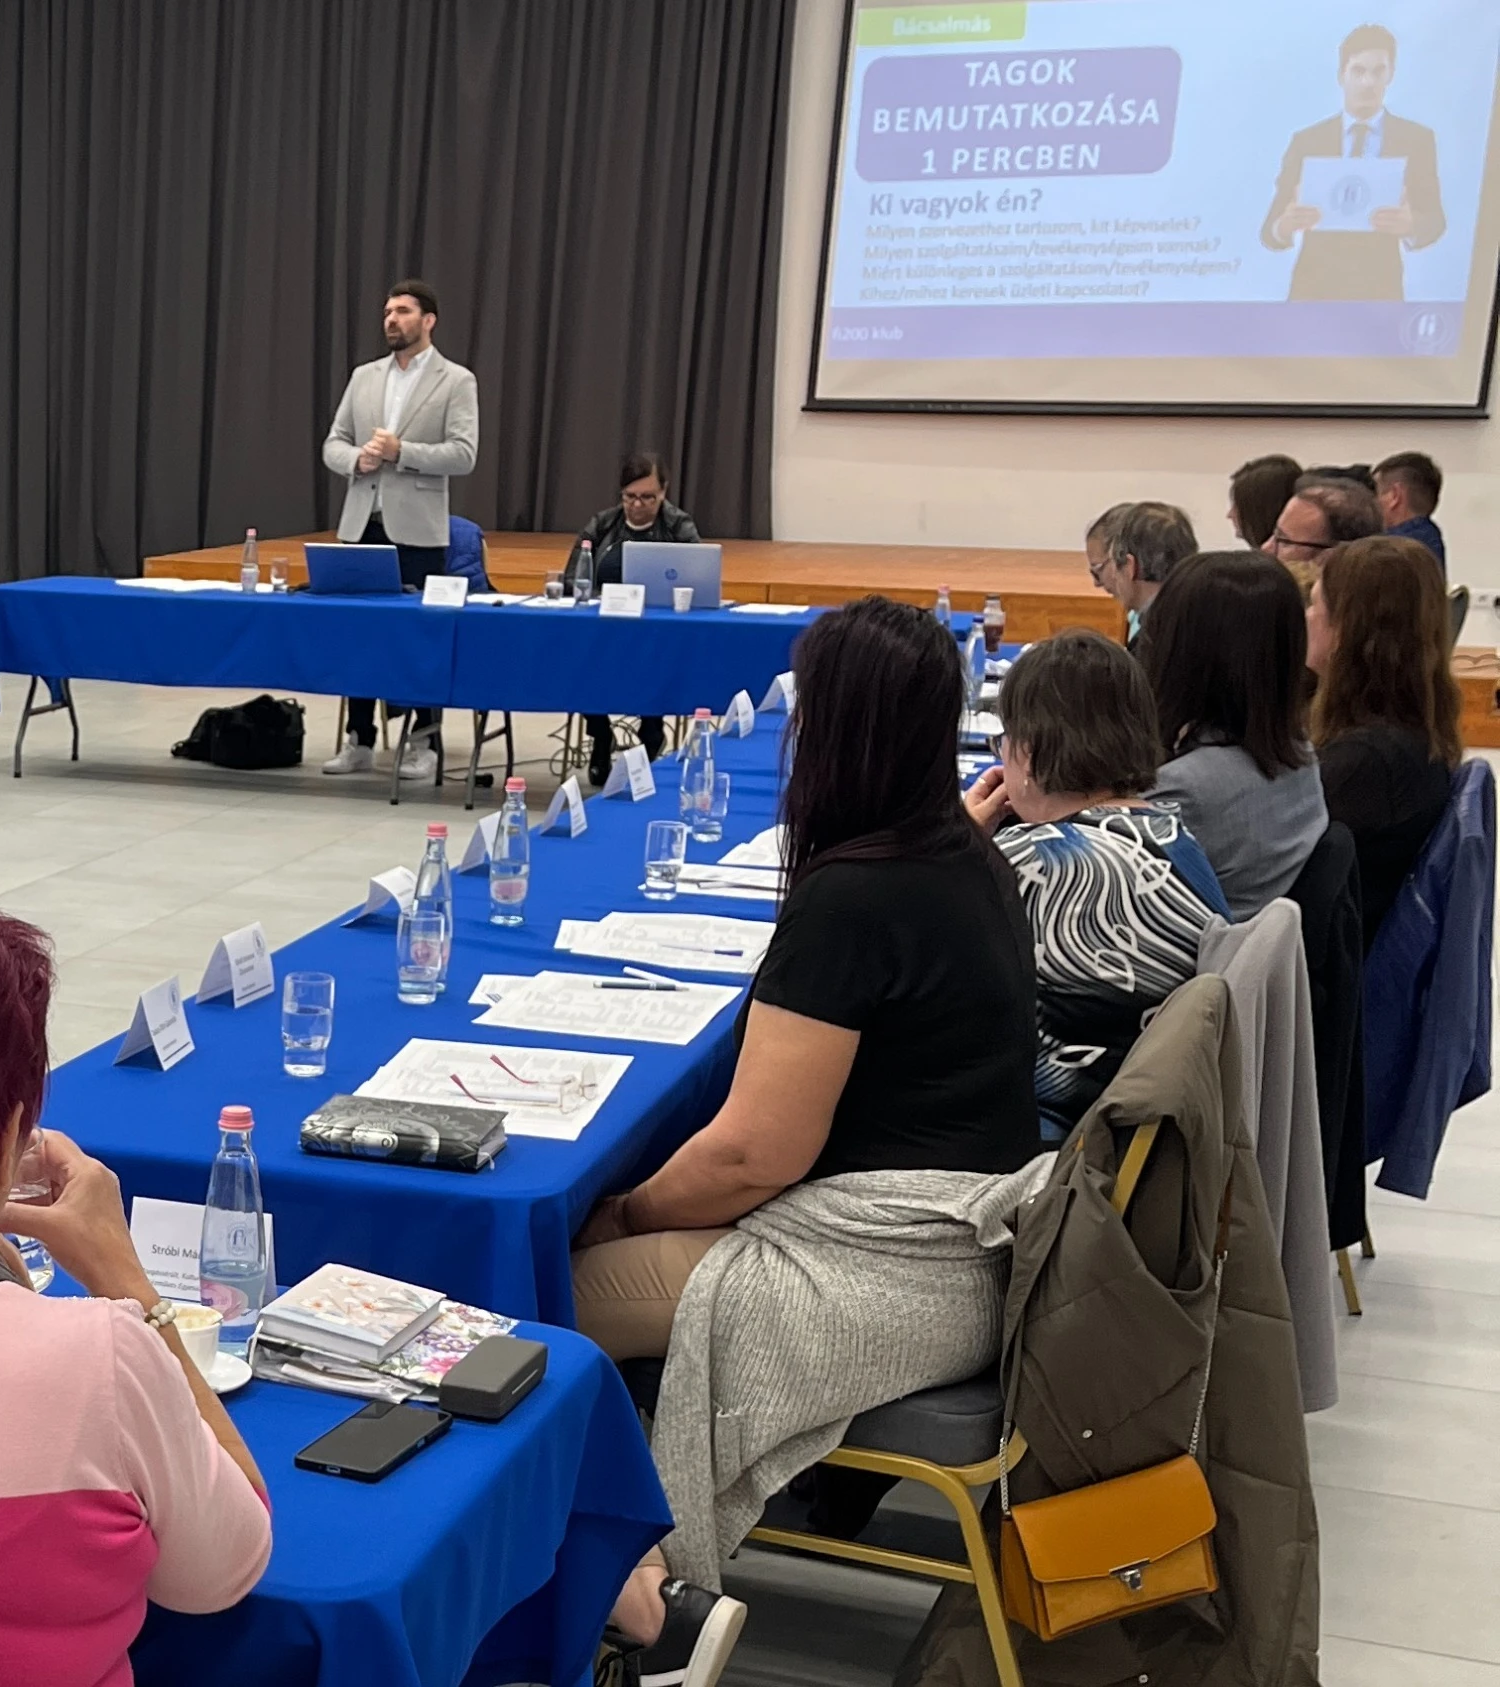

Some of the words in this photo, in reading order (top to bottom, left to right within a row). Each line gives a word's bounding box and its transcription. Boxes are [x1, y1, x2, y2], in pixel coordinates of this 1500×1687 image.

[964, 58, 1078, 87] TAGOK
[873, 94, 1160, 133] BEMUTATKOZÁSA
[921, 149, 936, 174] 1
[951, 143, 1101, 173] PERCBEN
[869, 193, 893, 215] Ki
[900, 190, 990, 220] vagyok
[996, 188, 1043, 212] én?
[866, 223, 915, 241] Milyen
[864, 245, 913, 262] Milyen
[872, 325, 904, 341] klub
